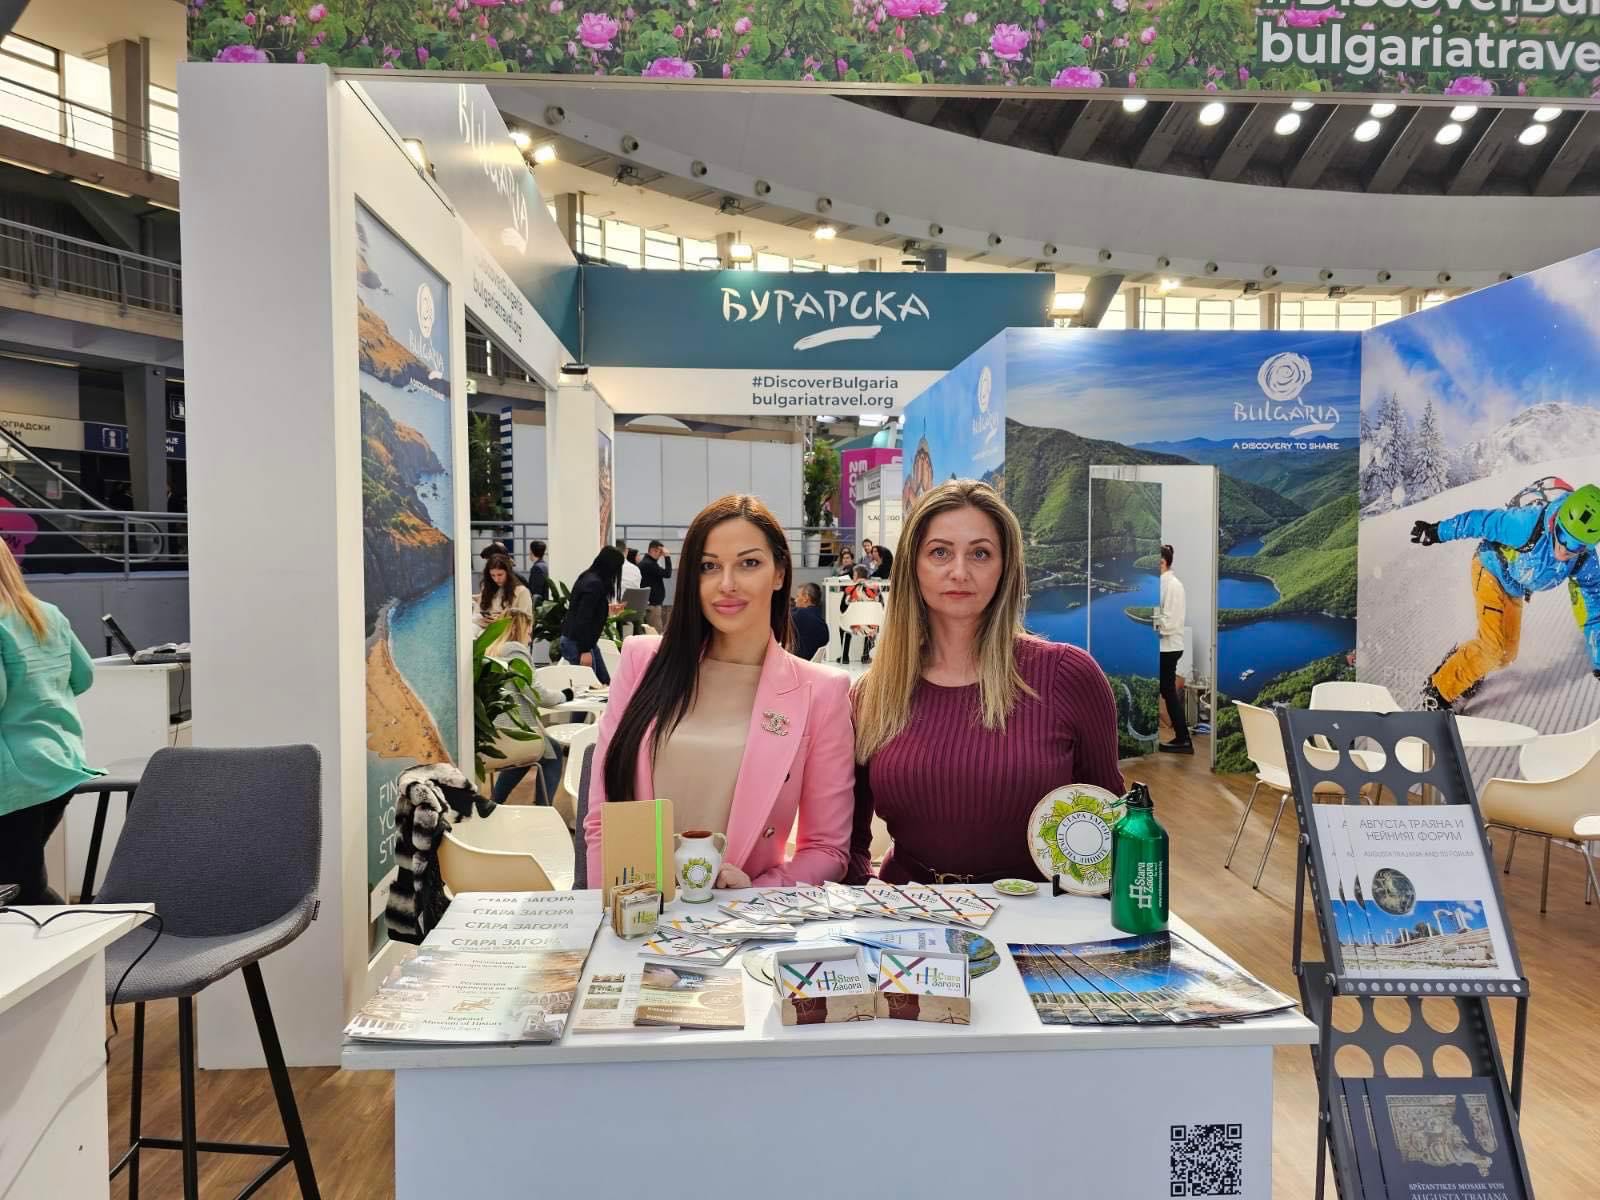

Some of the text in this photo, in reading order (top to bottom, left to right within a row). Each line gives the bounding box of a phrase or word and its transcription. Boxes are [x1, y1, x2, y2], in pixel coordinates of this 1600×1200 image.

[1262, 22, 1600, 75] bulgariatrave
[720, 287, 930, 325] БУГАРСКА
[752, 376, 899, 392] #DiscoverBulgaria
[752, 393, 894, 409] bulgariatravel.org
[1233, 399, 1340, 424] BULGARIA
[1232, 442, 1340, 450] A DISCOVERY TO SHARE
[379, 776, 399, 808] FIN
[1360, 819, 1407, 829] АВГУСТА
[1408, 819, 1452, 829] ТРАЯНА
[1453, 819, 1464, 829] И
[1366, 830, 1463, 842] НЕЙНИЯТ ФОРУМ
[1134, 862, 1146, 886] Stara
[472, 908, 575, 916] СТАРА ЗАГОРА
[464, 921, 570, 930] СТАРА ЗАГОРА
[451, 938, 497, 947] СТАРА
[836, 973, 861, 983] Stara
